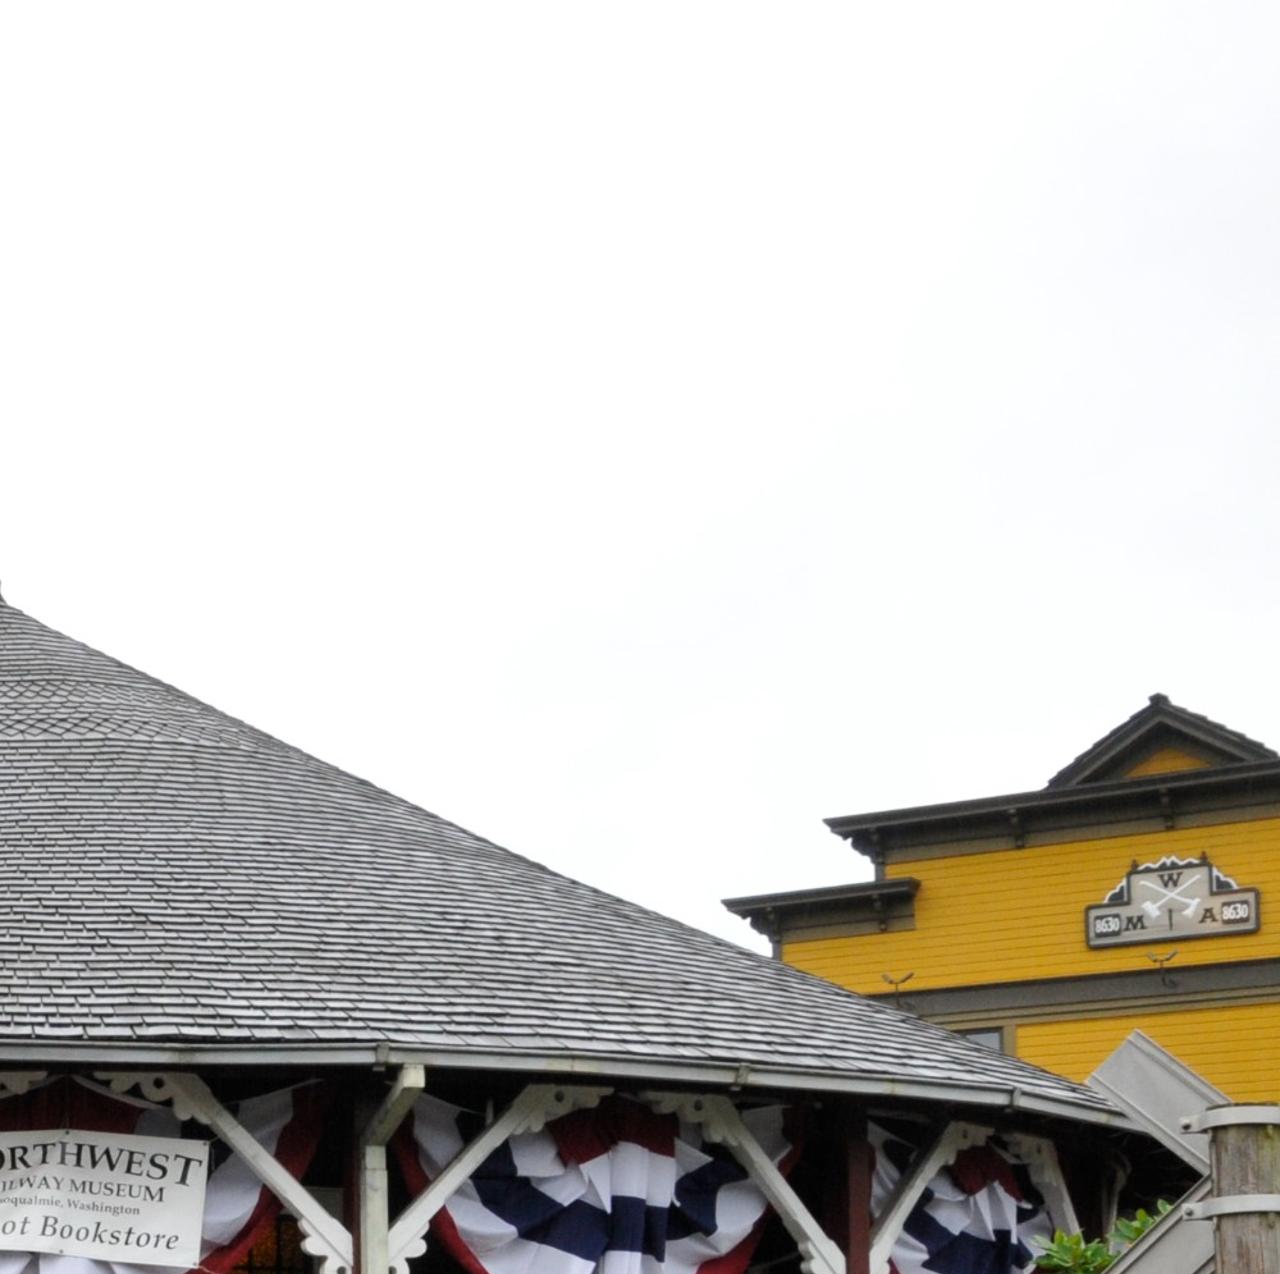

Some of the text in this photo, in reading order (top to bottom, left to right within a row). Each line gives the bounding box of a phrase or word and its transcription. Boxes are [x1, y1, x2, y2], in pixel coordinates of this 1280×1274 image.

[1157, 871, 1183, 888] W
[1123, 914, 1148, 931] M
[1198, 907, 1218, 924] A
[69, 1178, 167, 1203] MUSEUM
[66, 1198, 141, 1217] Washington
[39, 1214, 180, 1250] Bookstore
